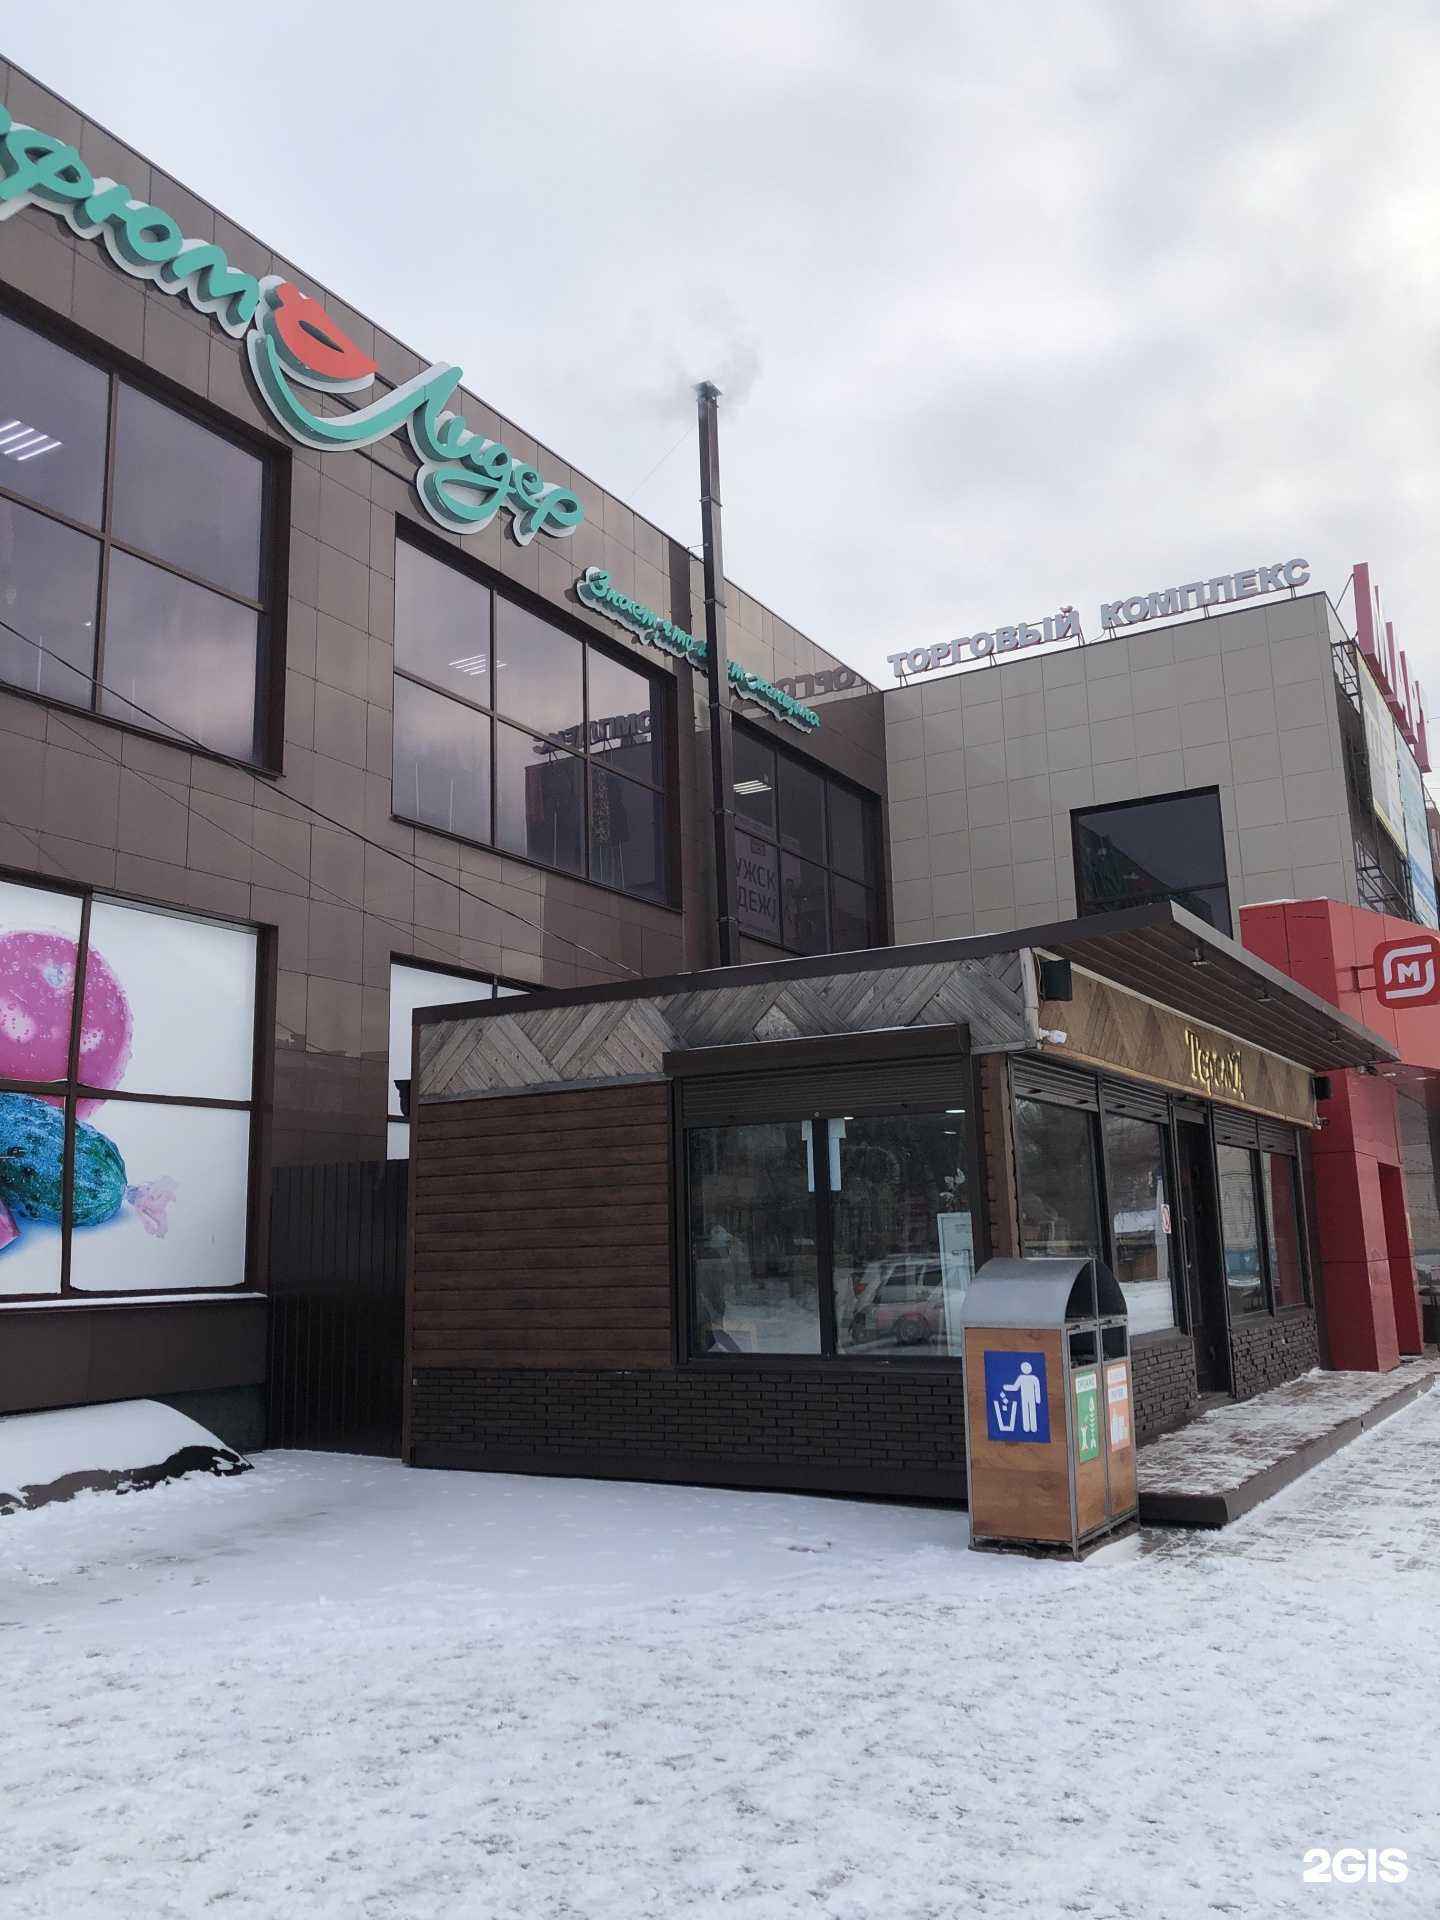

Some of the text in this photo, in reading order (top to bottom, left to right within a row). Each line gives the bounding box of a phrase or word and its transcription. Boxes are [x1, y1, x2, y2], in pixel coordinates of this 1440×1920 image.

[248, 330, 584, 544] Лидер
[887, 558, 1311, 678] ТОРГОВЫЙ КОМПЛЕКС
